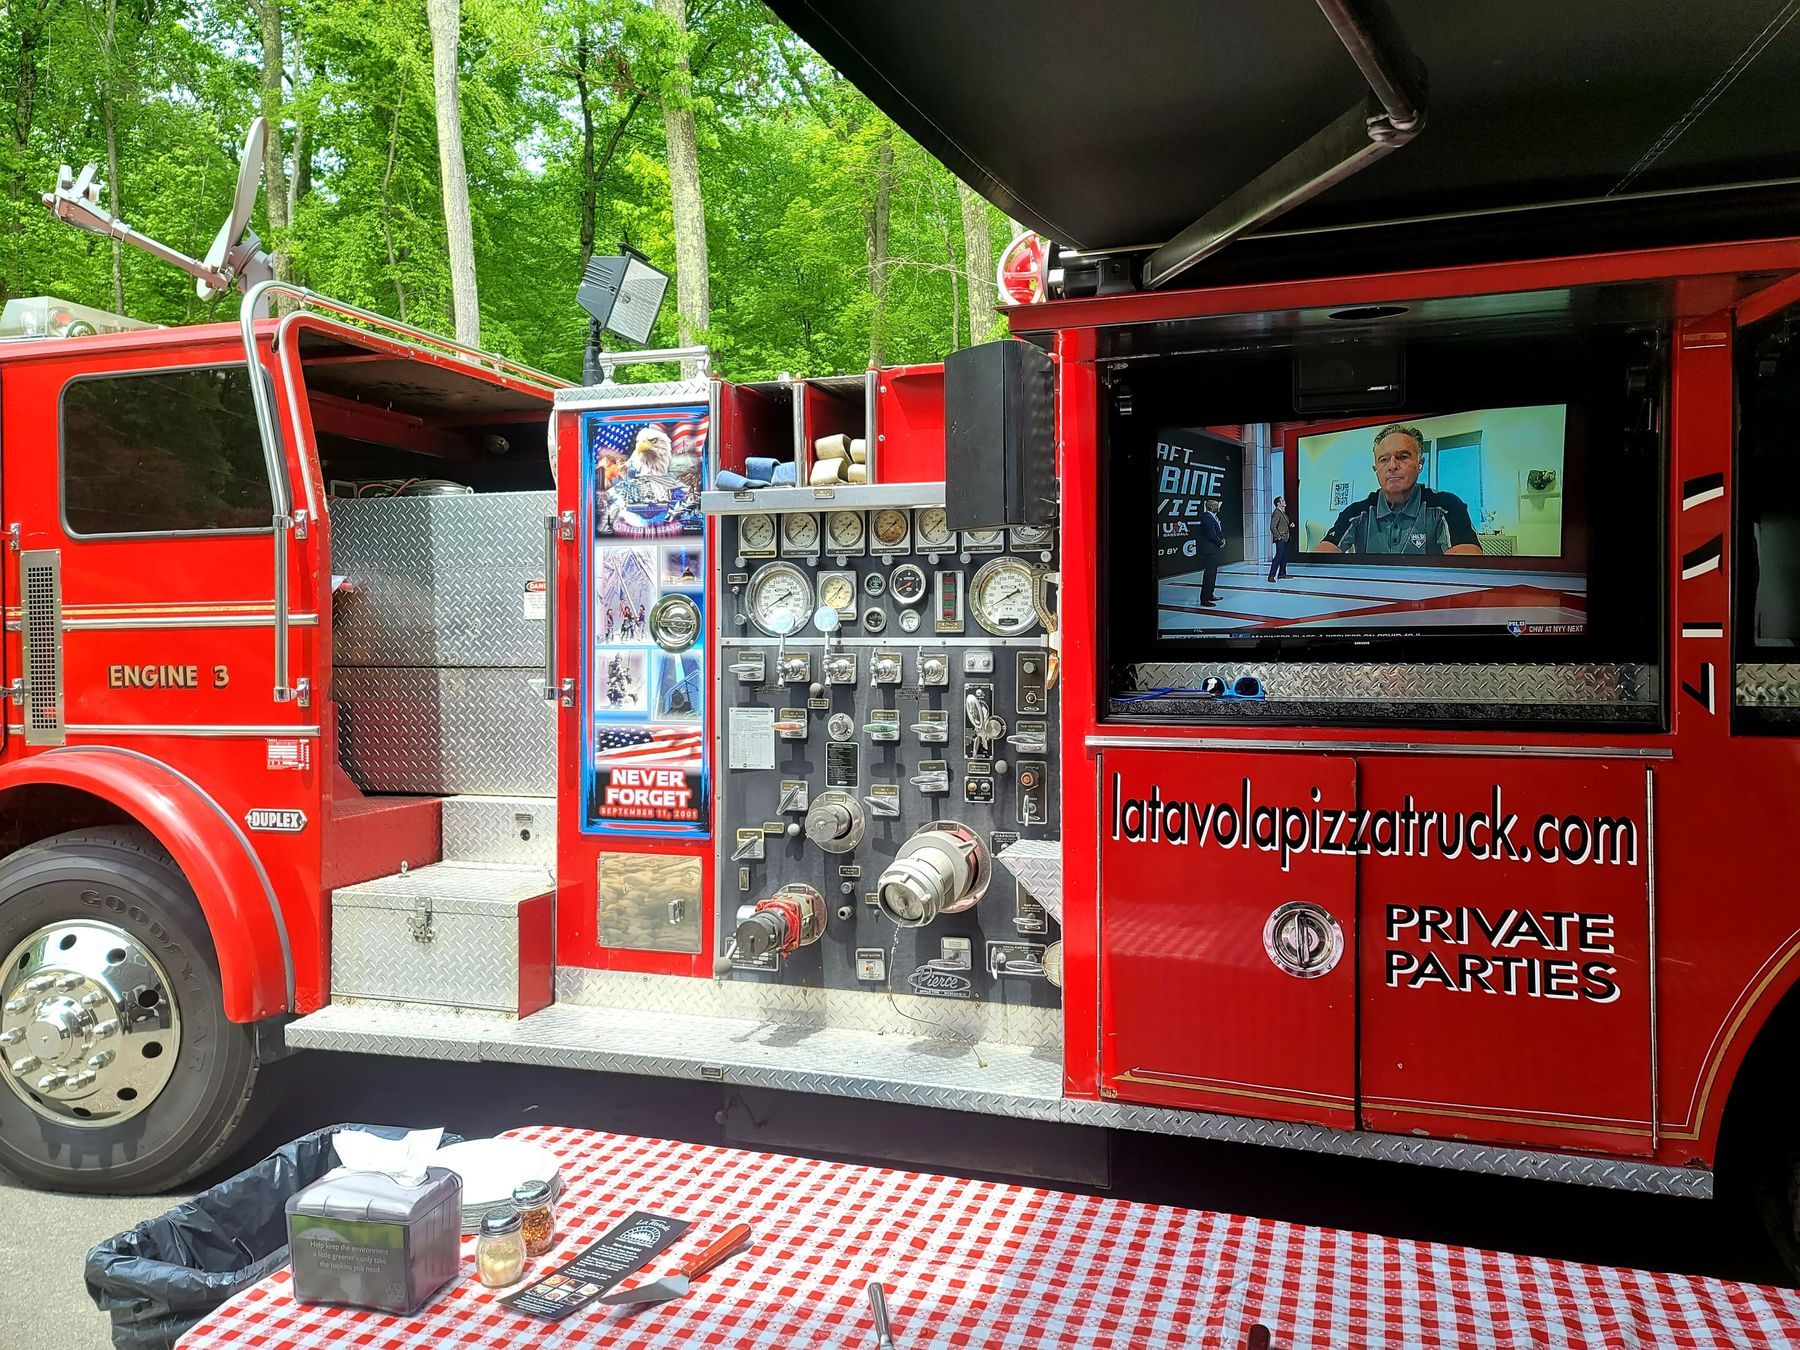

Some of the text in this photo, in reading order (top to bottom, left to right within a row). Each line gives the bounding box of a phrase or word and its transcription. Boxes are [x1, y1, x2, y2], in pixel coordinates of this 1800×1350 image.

[1157, 465, 1224, 497] BINE
[1166, 547, 1178, 555] BY
[1528, 625, 1544, 633] CHW
[1544, 625, 1552, 633] AT
[108, 664, 230, 689] ENGINE 3
[611, 768, 685, 787] NEVER
[606, 787, 691, 807] FORGET
[251, 811, 299, 828] DUPLEX
[600, 807, 654, 816] SEPTEMBER
[1111, 771, 1638, 872] latavolapizzatruck.com
[1385, 903, 1615, 953] PRIVATE
[915, 964, 958, 988] Pierce
[1385, 949, 1622, 1003] PARTIES
[310, 1241, 324, 1249] Help
[325, 1242, 340, 1251] keep
[318, 1251, 331, 1259] little
[332, 1254, 354, 1262] greener
[360, 1256, 373, 1264] only
[330, 1263, 353, 1271] napkins
